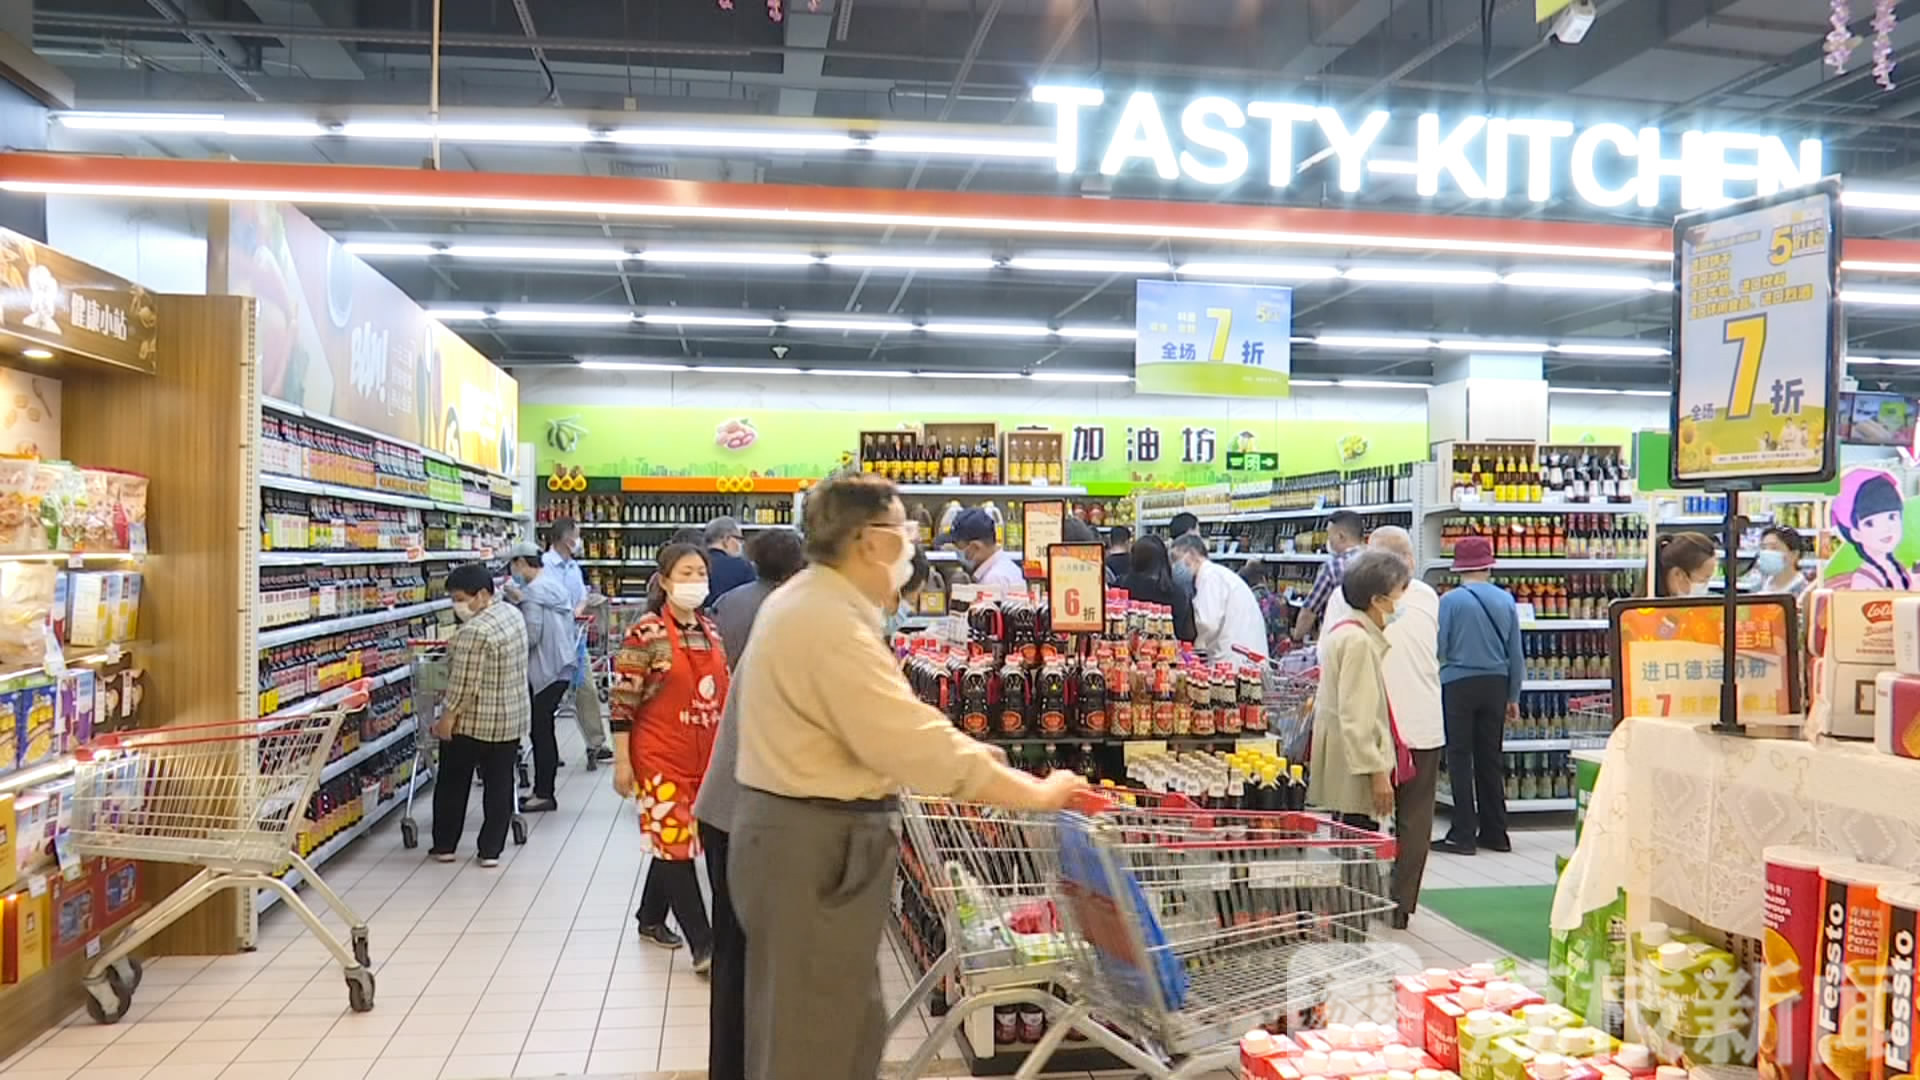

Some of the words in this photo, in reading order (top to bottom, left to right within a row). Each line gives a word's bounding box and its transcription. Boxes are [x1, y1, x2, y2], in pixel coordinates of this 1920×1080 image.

[1032, 85, 1390, 193] TASTY
[1416, 112, 1822, 210] KITCHEN
[72, 291, 128, 341] 健康小站
[1162, 342, 1196, 360] 全场
[1206, 307, 1233, 361] 7
[1241, 340, 1265, 364] 折
[1691, 403, 1715, 421] 全场
[1722, 312, 1767, 420] 7
[1770, 378, 1804, 415] 折
[1017, 425, 1216, 463] 加油坊
[1064, 588, 1080, 616] 6
[1083, 607, 1096, 621] 折
[1819, 902, 1844, 1032] Fessto
[1885, 930, 1913, 1072] Fessto
